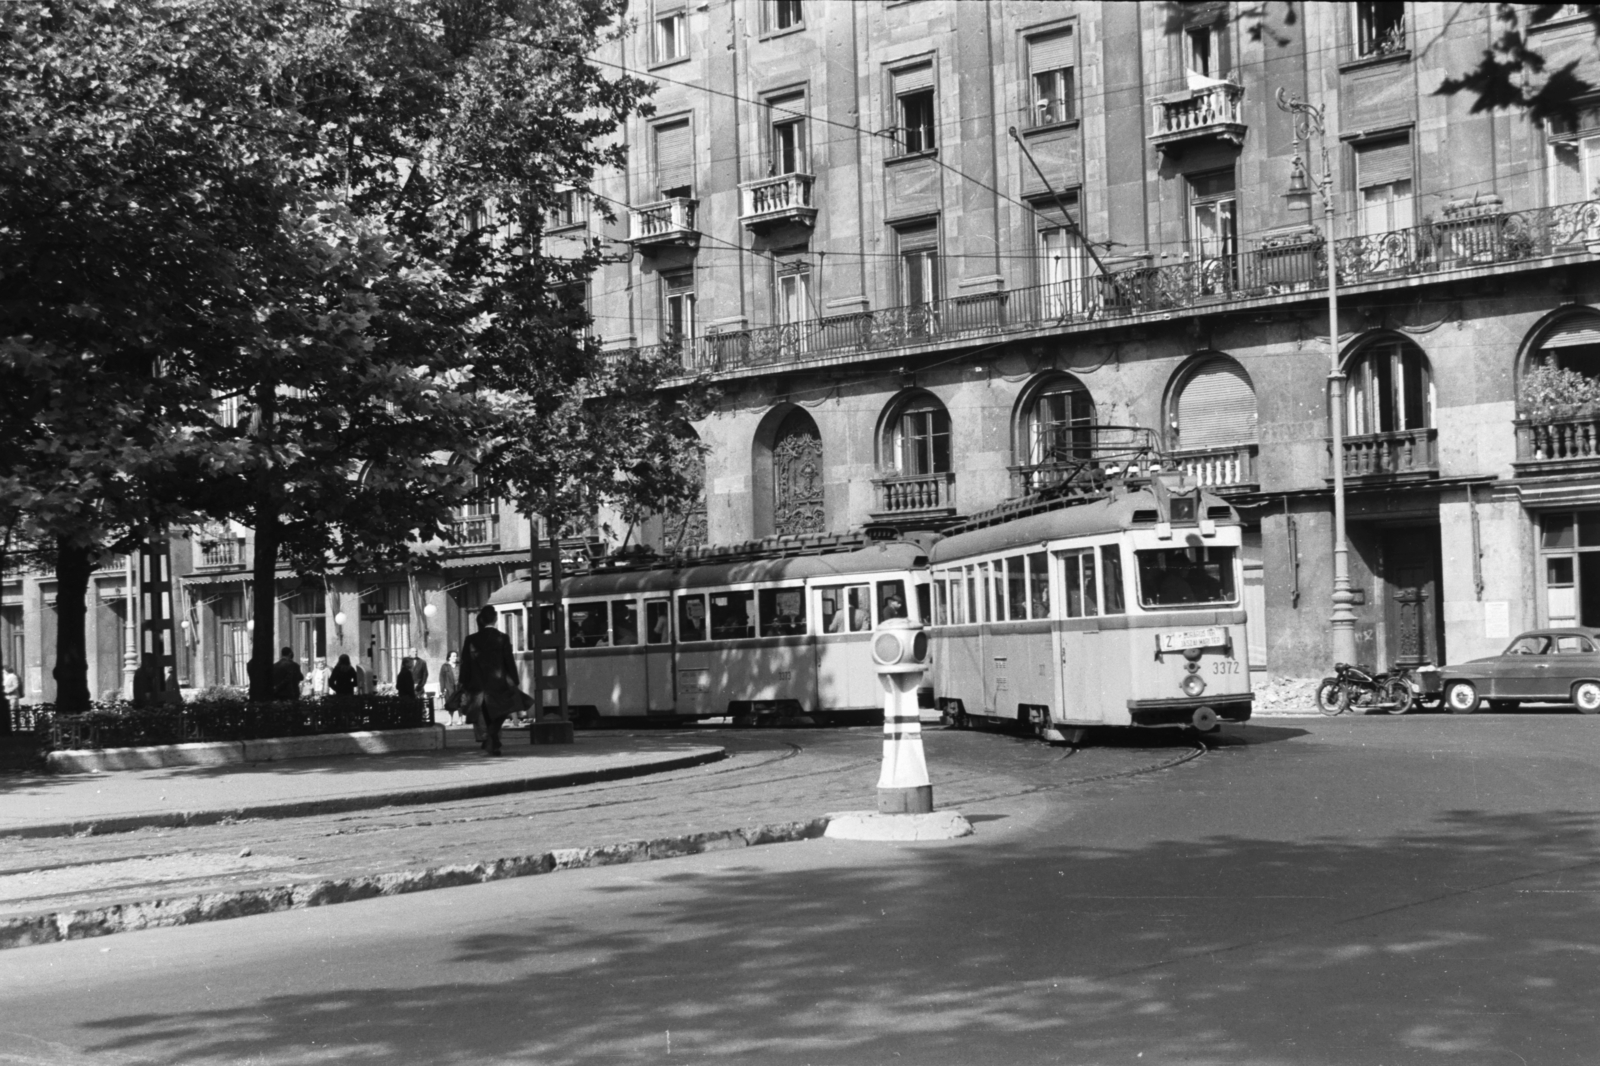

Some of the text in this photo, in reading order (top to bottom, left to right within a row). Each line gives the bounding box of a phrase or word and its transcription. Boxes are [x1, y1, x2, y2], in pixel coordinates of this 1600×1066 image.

[368, 604, 376, 614] M
[1166, 635, 1172, 648] 2
[1212, 662, 1240, 674] 3372
